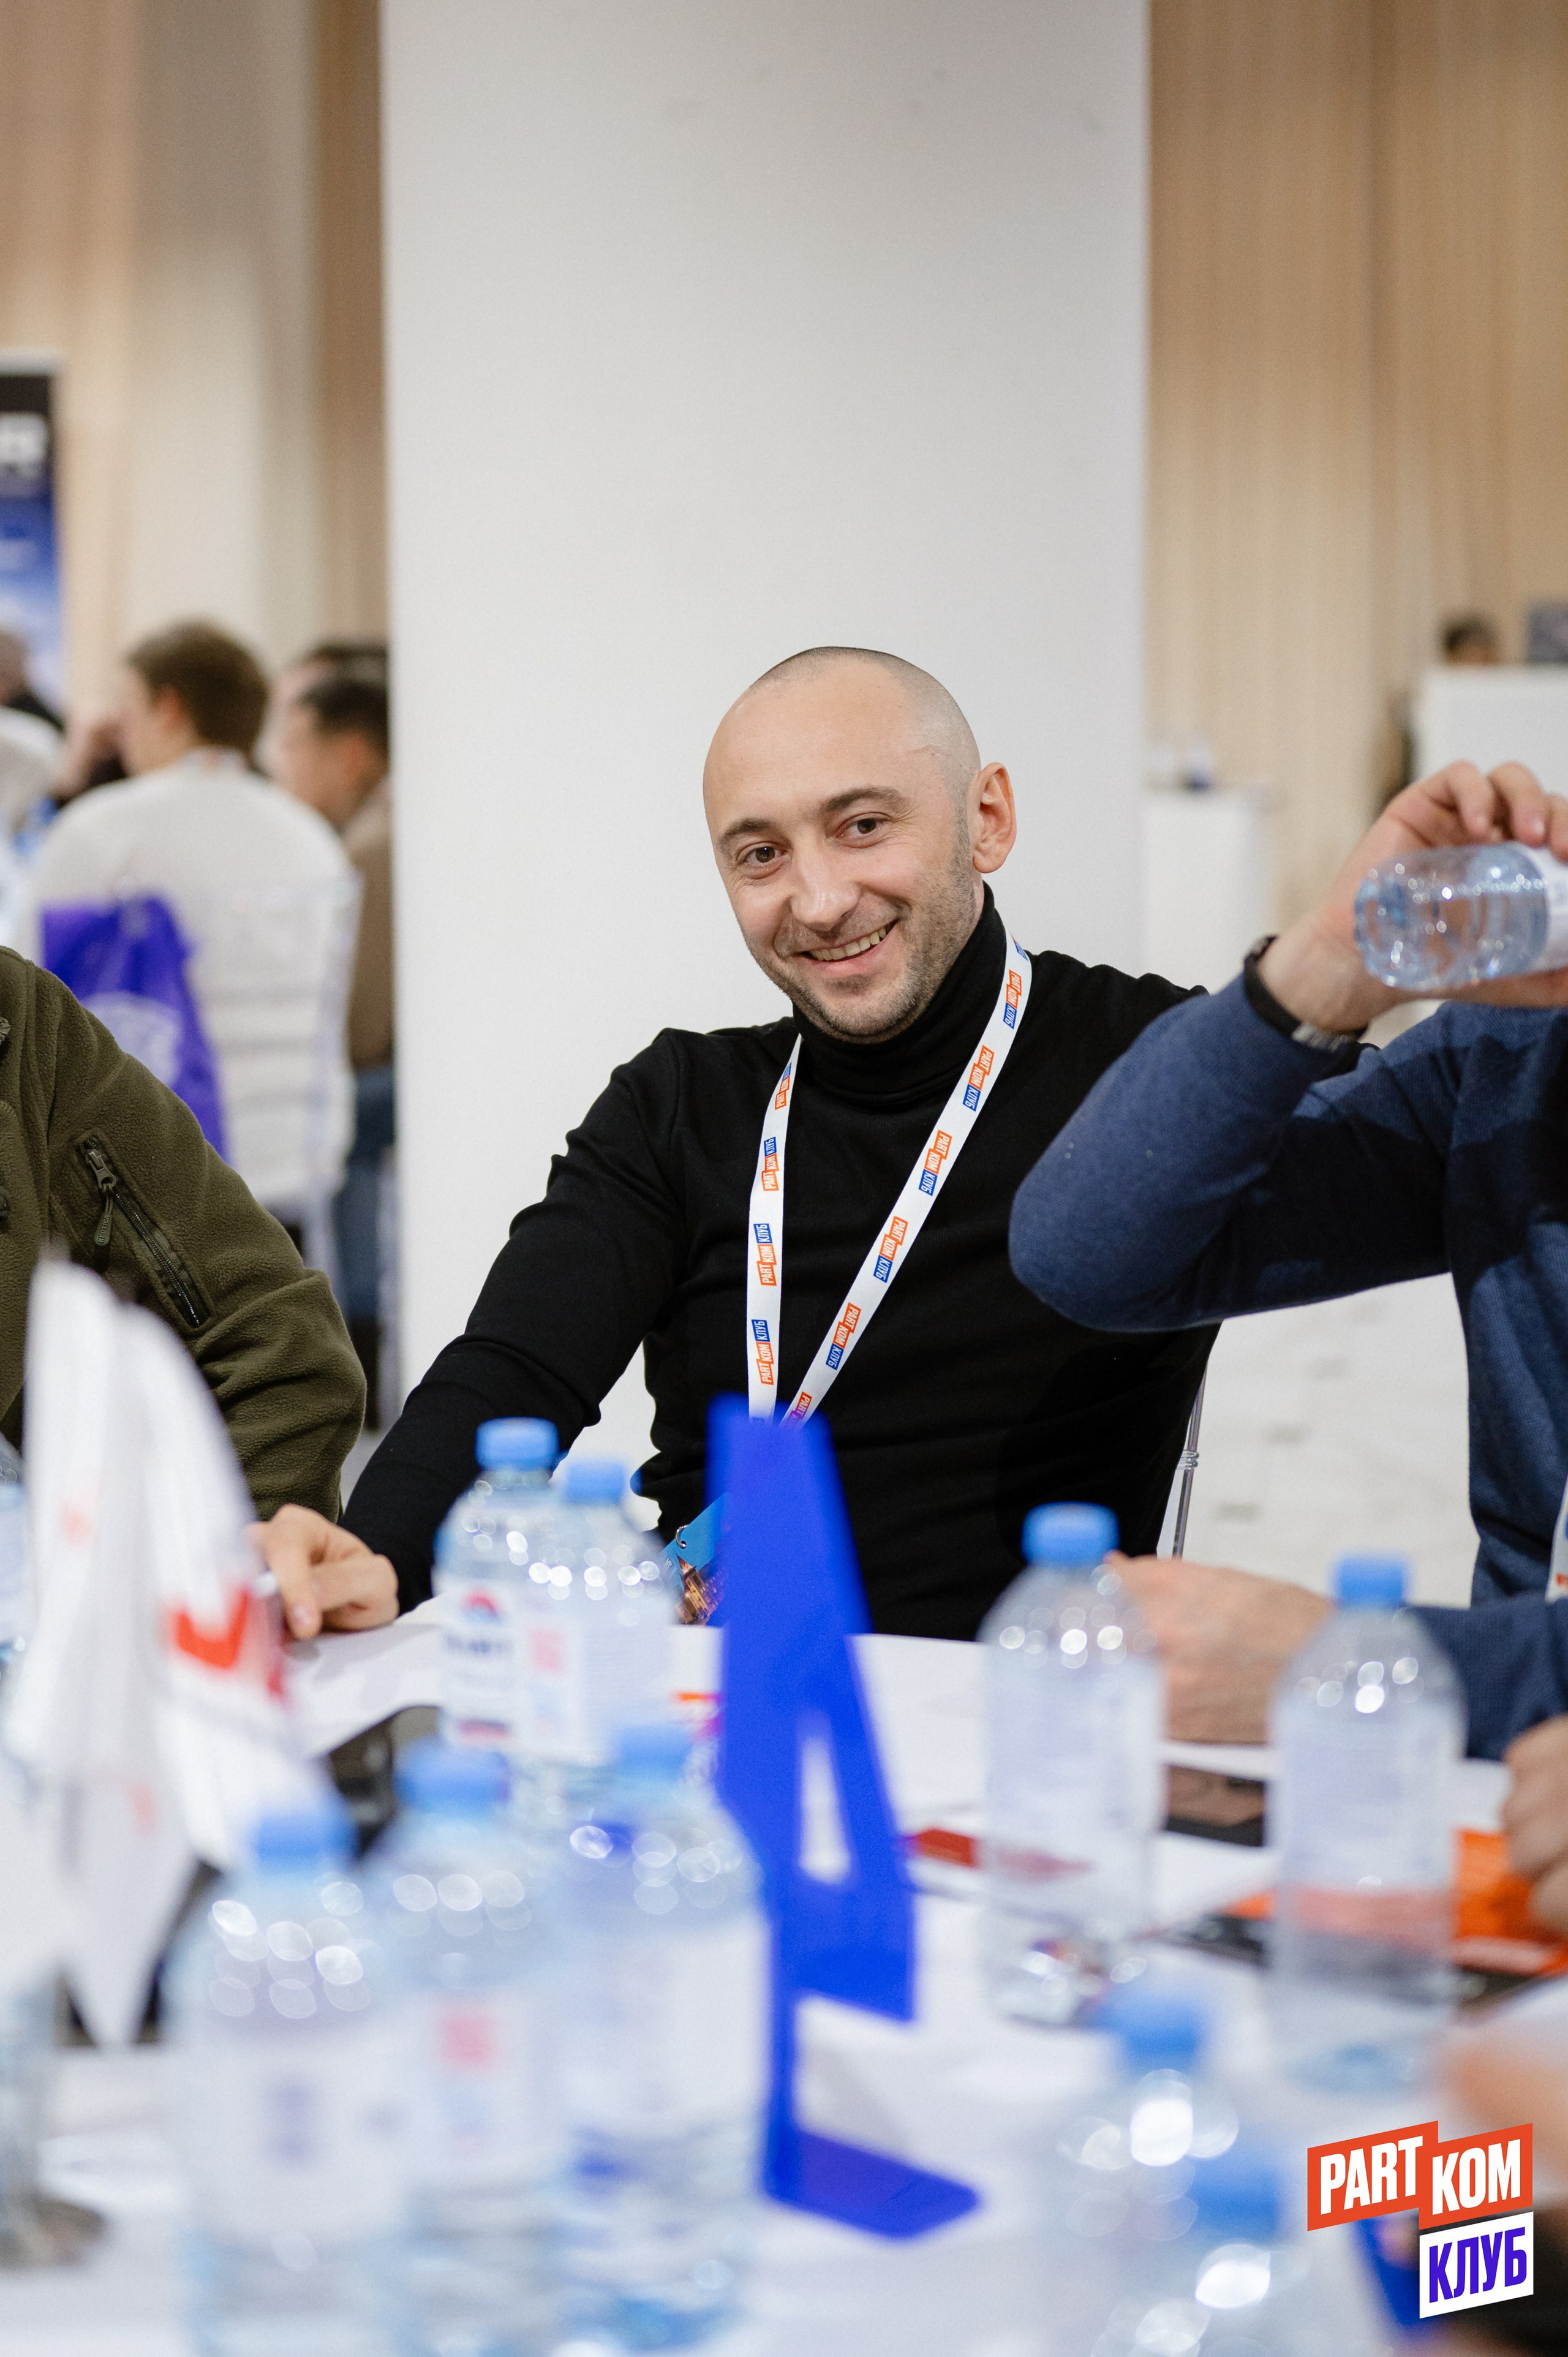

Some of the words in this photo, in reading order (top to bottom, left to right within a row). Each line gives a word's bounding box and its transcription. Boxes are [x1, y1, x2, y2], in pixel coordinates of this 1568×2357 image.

[1005, 1005, 1016, 1027] КЛУБ
[979, 1048, 992, 1072] PART
[965, 1087, 979, 1109] КЛУБ
[765, 1138, 775, 1155] КЛУБ
[935, 1133, 950, 1156] PART
[921, 1172, 935, 1194] КЛУБ
[756, 1224, 771, 1242] КЛУБ
[891, 1218, 906, 1242] PART
[759, 1263, 774, 1284] PART
[875, 1258, 891, 1280] КЛУБ
[844, 1305, 859, 1330] PART
[754, 1321, 768, 1340] КЛУБ
[827, 1346, 842, 1368] КЛУБ
[758, 1362, 772, 1382] PART
